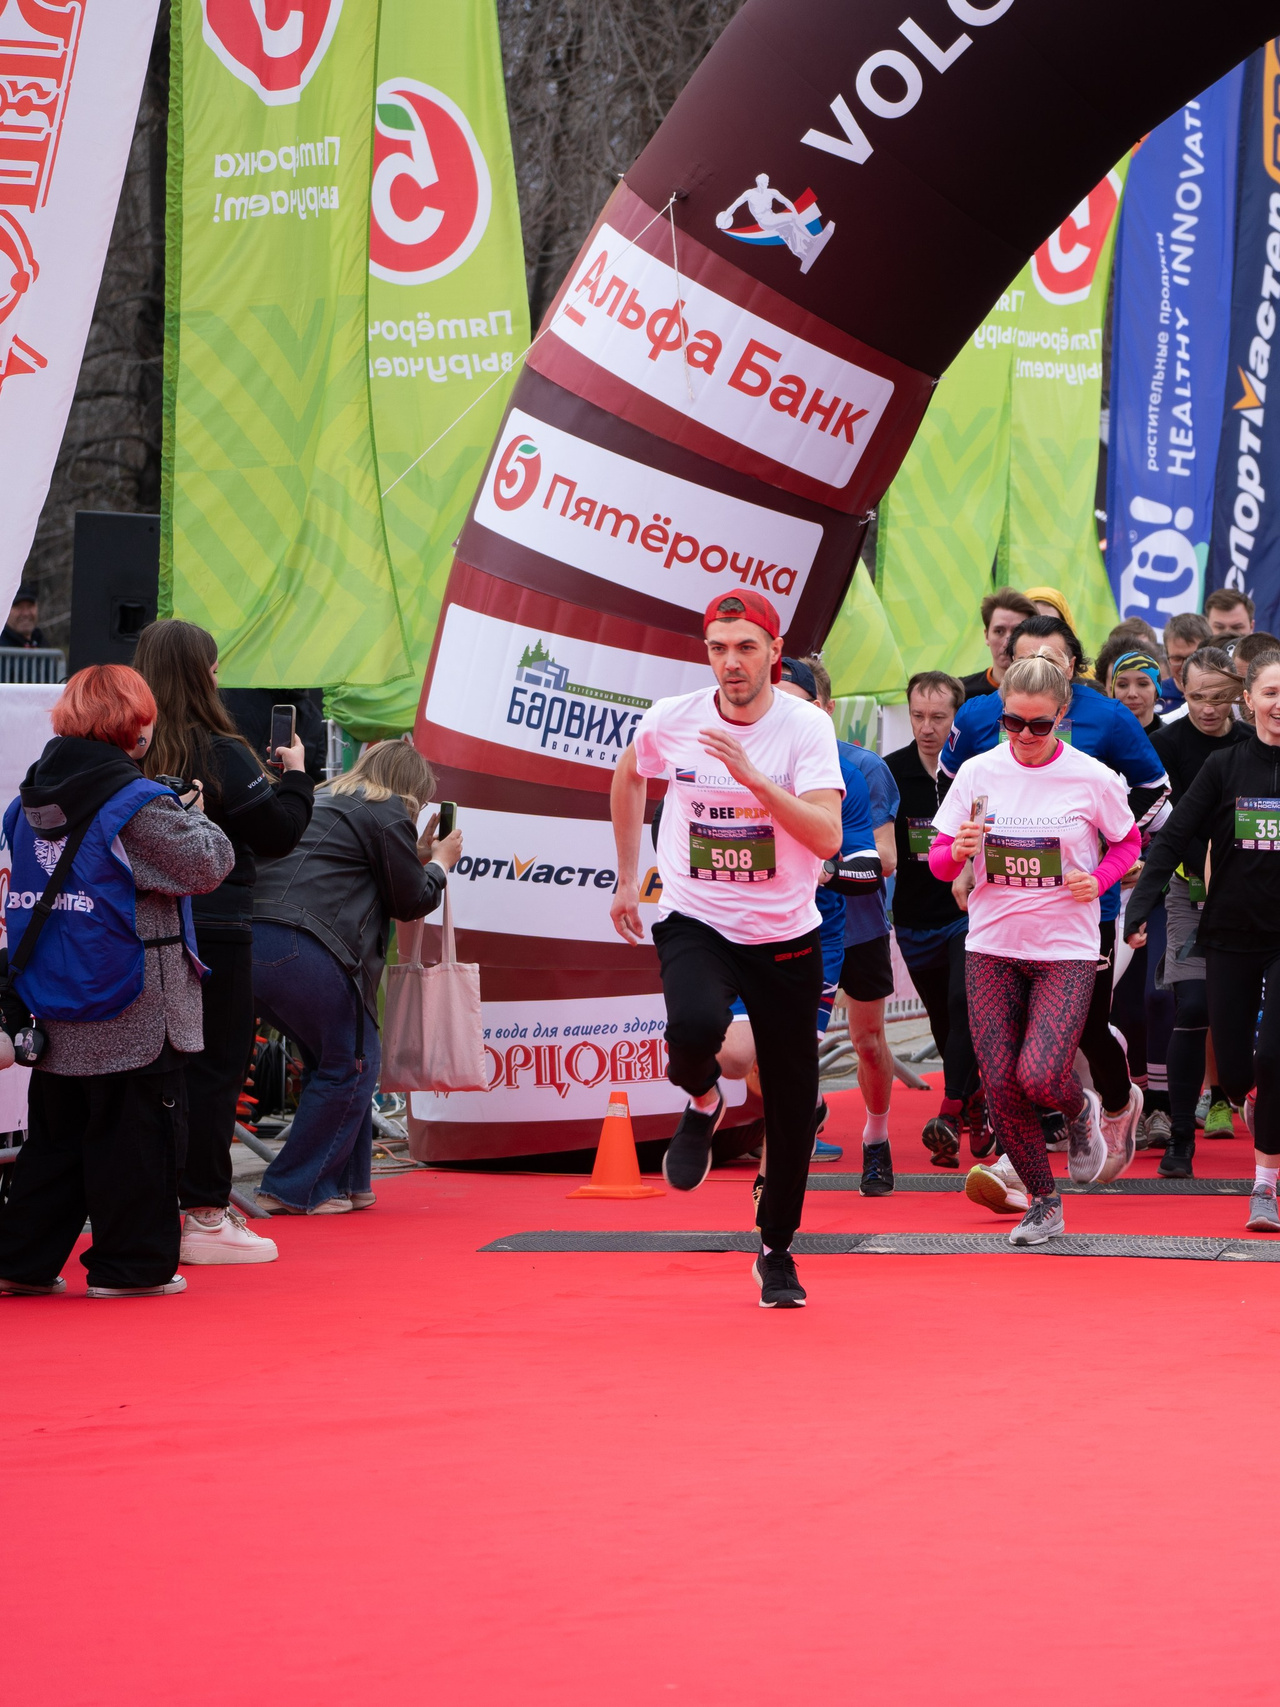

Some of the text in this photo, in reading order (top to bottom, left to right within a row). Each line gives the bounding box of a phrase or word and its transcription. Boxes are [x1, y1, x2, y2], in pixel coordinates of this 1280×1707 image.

[574, 249, 871, 444] Альфа Банк
[1147, 231, 1171, 472] растительные продукты
[1168, 307, 1196, 477] HEALTHY
[542, 472, 799, 597] Пятёрочка
[997, 817, 1034, 826] ОПОРА
[711, 848, 753, 869] 508
[1005, 856, 1041, 876] 509
[495, 1023, 527, 1039] вода
[533, 1022, 558, 1038] для
[563, 1023, 618, 1037] вашего
